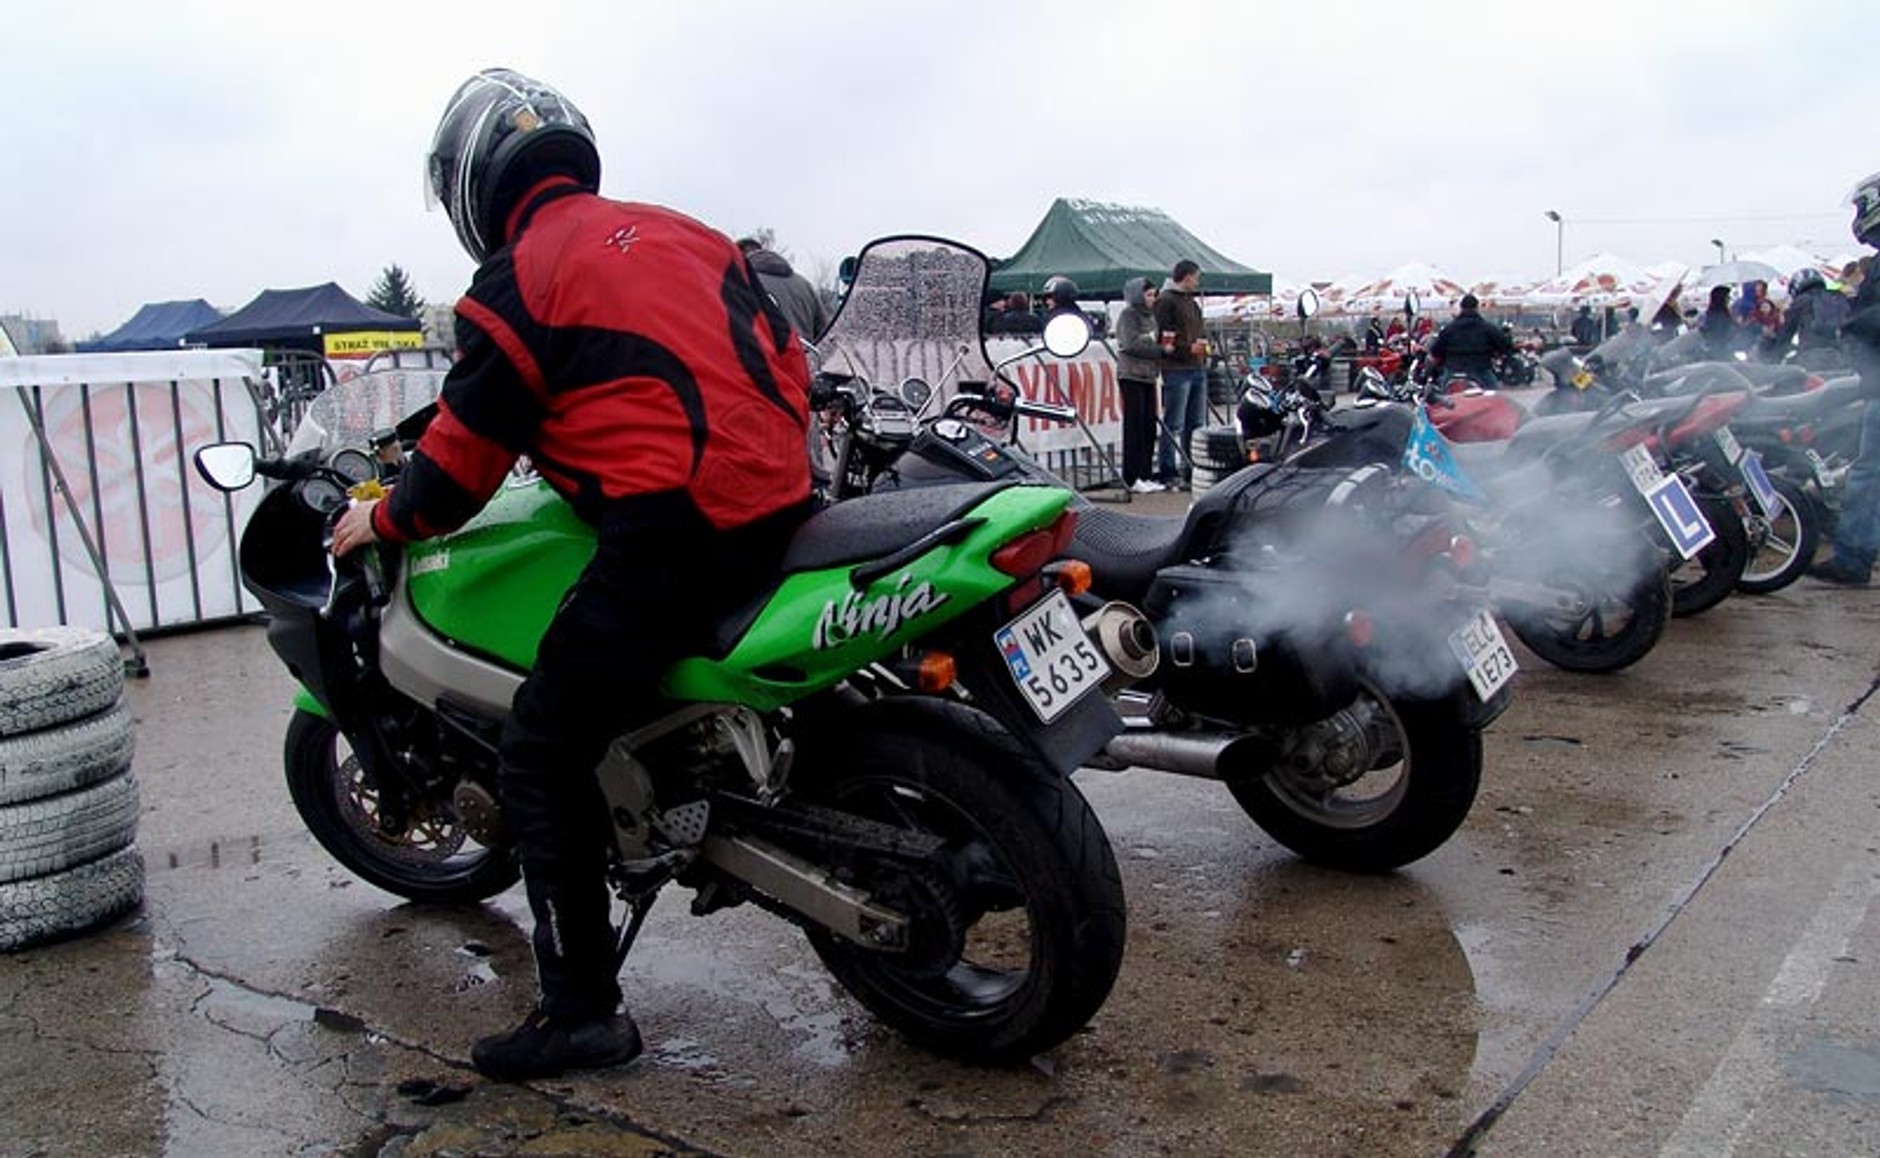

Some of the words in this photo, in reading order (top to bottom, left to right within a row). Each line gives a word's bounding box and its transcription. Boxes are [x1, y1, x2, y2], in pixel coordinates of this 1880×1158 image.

[1016, 361, 1125, 432] YAMA
[1660, 493, 1702, 540] L
[812, 571, 951, 650] Ninja
[1023, 610, 1064, 657] WK
[1027, 641, 1099, 707] 5635
[1475, 645, 1512, 690] 1E73
